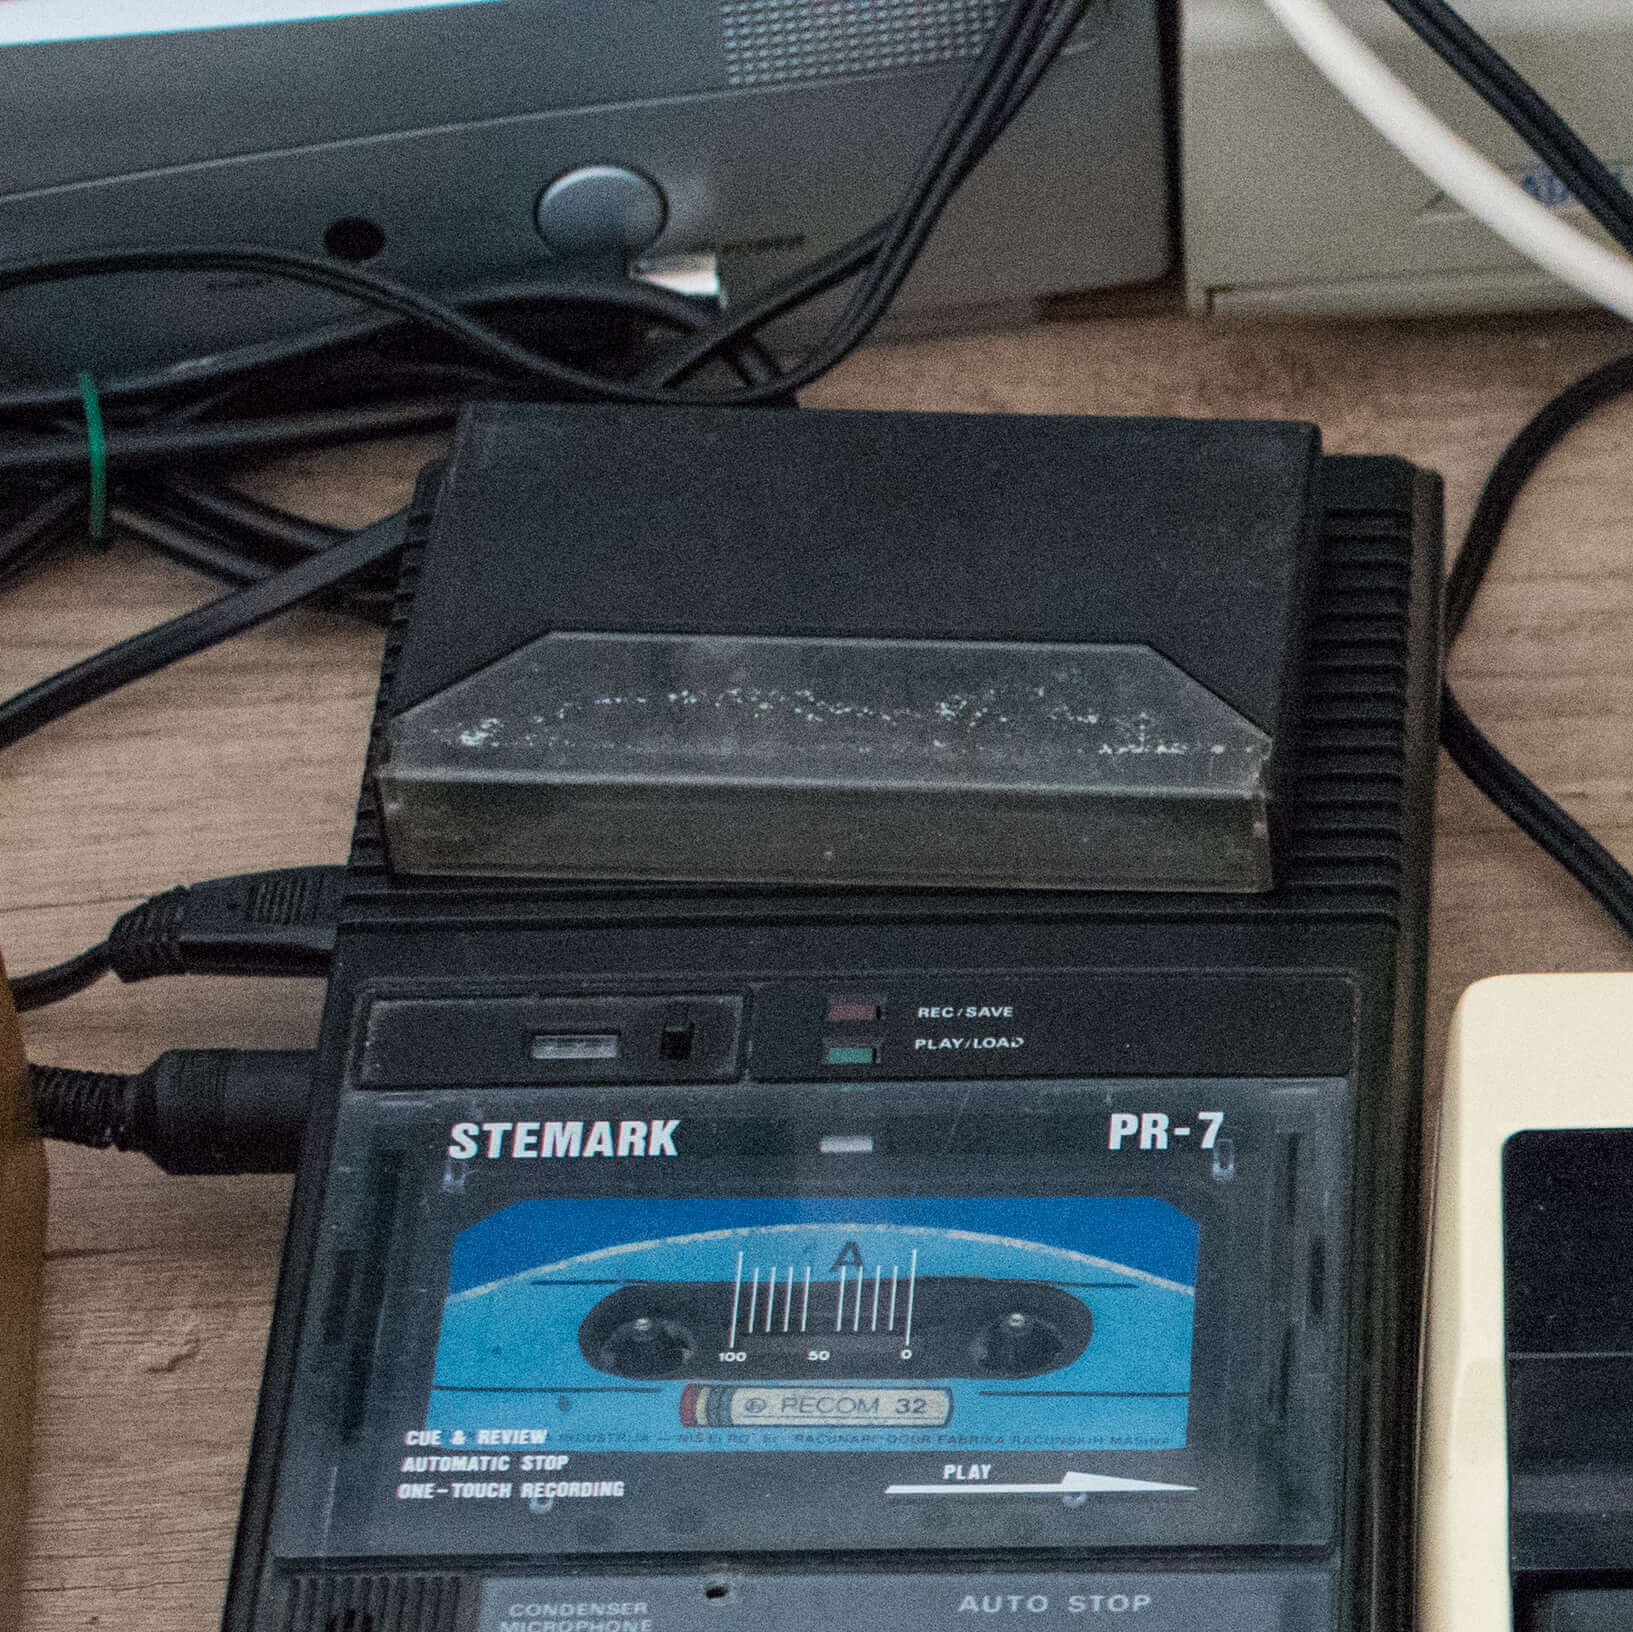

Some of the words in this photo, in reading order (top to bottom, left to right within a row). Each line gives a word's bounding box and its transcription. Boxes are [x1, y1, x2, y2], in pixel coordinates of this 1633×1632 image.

[917, 1006, 1013, 1019] REC/SAVE
[914, 1036, 1025, 1050] PLAY/LOAD
[447, 1119, 682, 1161] STEMARK
[1107, 1111, 1225, 1150] PR-7
[829, 1241, 863, 1273] A
[719, 1351, 747, 1362] 100
[808, 1350, 830, 1361] 50
[900, 1348, 913, 1360] 0
[780, 1396, 880, 1414] PECOM
[895, 1397, 928, 1413] 32
[402, 1428, 444, 1447] CUE
[450, 1429, 466, 1446] &
[475, 1428, 548, 1447] REVIEW
[400, 1454, 512, 1474] AUTOMATIC
[520, 1453, 570, 1471] STOP
[943, 1464, 992, 1480] PLAY
[397, 1481, 513, 1500] ONE-TOUCH
[519, 1479, 626, 1499] RECORDING
[509, 1602, 651, 1623] CONDENSER
[957, 1594, 1049, 1614] AUTO
[1068, 1594, 1152, 1613] STOP
